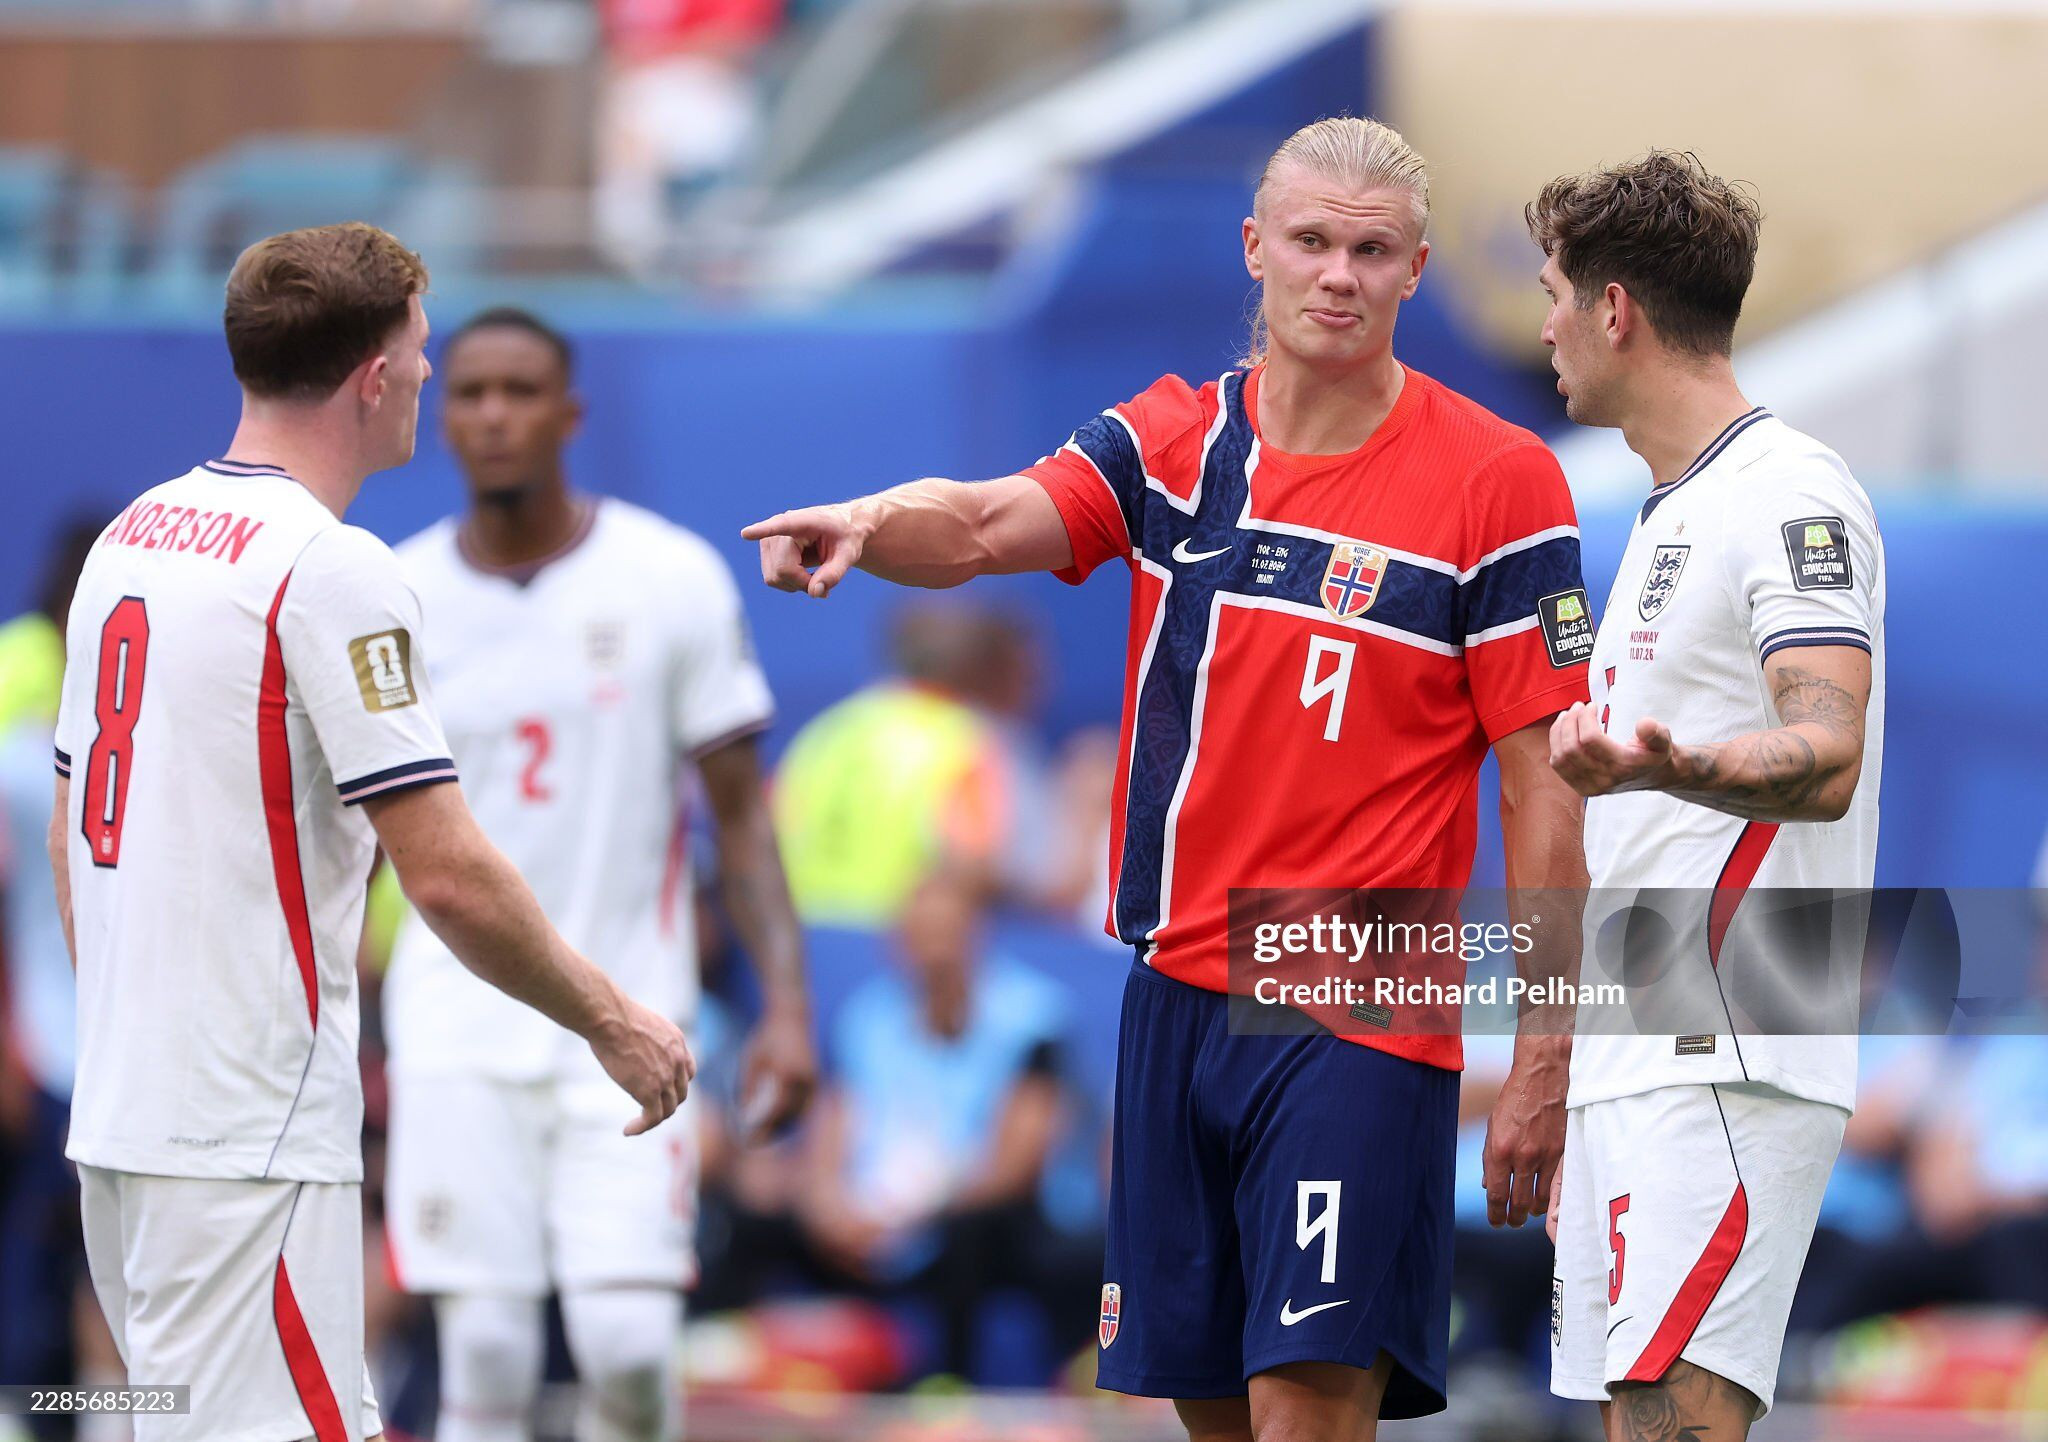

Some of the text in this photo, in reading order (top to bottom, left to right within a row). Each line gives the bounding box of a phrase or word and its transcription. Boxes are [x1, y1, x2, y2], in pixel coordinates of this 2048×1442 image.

[102, 500, 265, 564] ANDERSON
[1256, 543, 1271, 556] NOR
[1274, 546, 1290, 558] ENG
[1353, 546, 1371, 557] NORGE
[1805, 548, 1826, 563] Unite
[1251, 557, 1287, 572] 11.07.2026
[1801, 561, 1845, 576] EDUCATION
[1817, 574, 1834, 583] FIFA
[1557, 622, 1580, 638] Unite
[1629, 630, 1659, 644] NORWAY
[1572, 646, 1591, 657] FIFA
[1629, 647, 1654, 661] 11.07.26
[1299, 633, 1357, 742] 9
[82, 595, 149, 869] 8
[515, 716, 553, 802] 2
[1296, 1180, 1342, 1284] 9
[1608, 1193, 1630, 1307] 5
